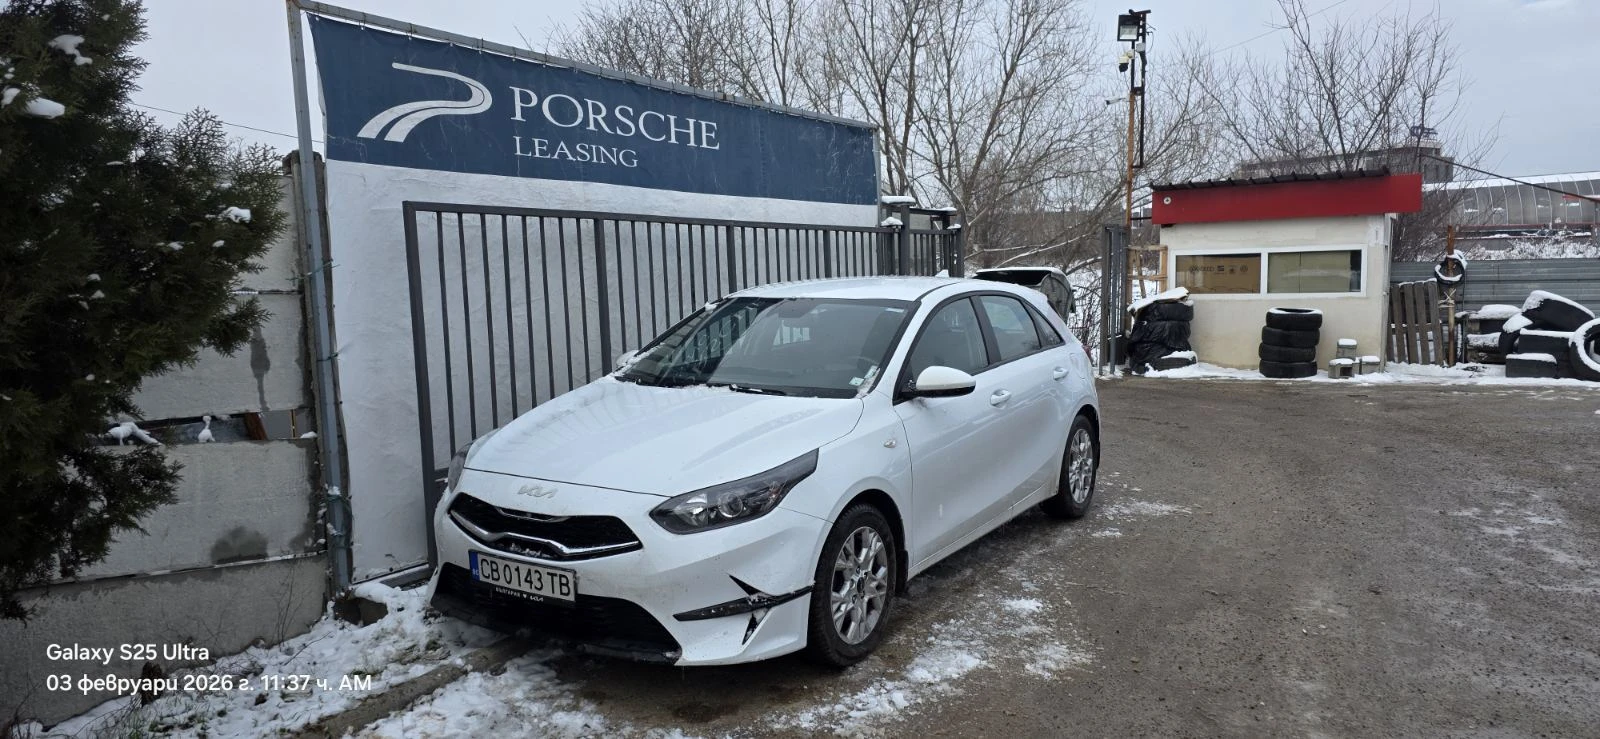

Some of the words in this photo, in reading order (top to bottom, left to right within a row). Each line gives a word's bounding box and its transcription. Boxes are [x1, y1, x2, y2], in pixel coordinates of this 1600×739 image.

[509, 86, 720, 150] PORSCHE
[513, 136, 638, 167] LEASING
[480, 559, 500, 582] CB
[503, 564, 544, 591] 0143
[546, 572, 571, 597] TB
